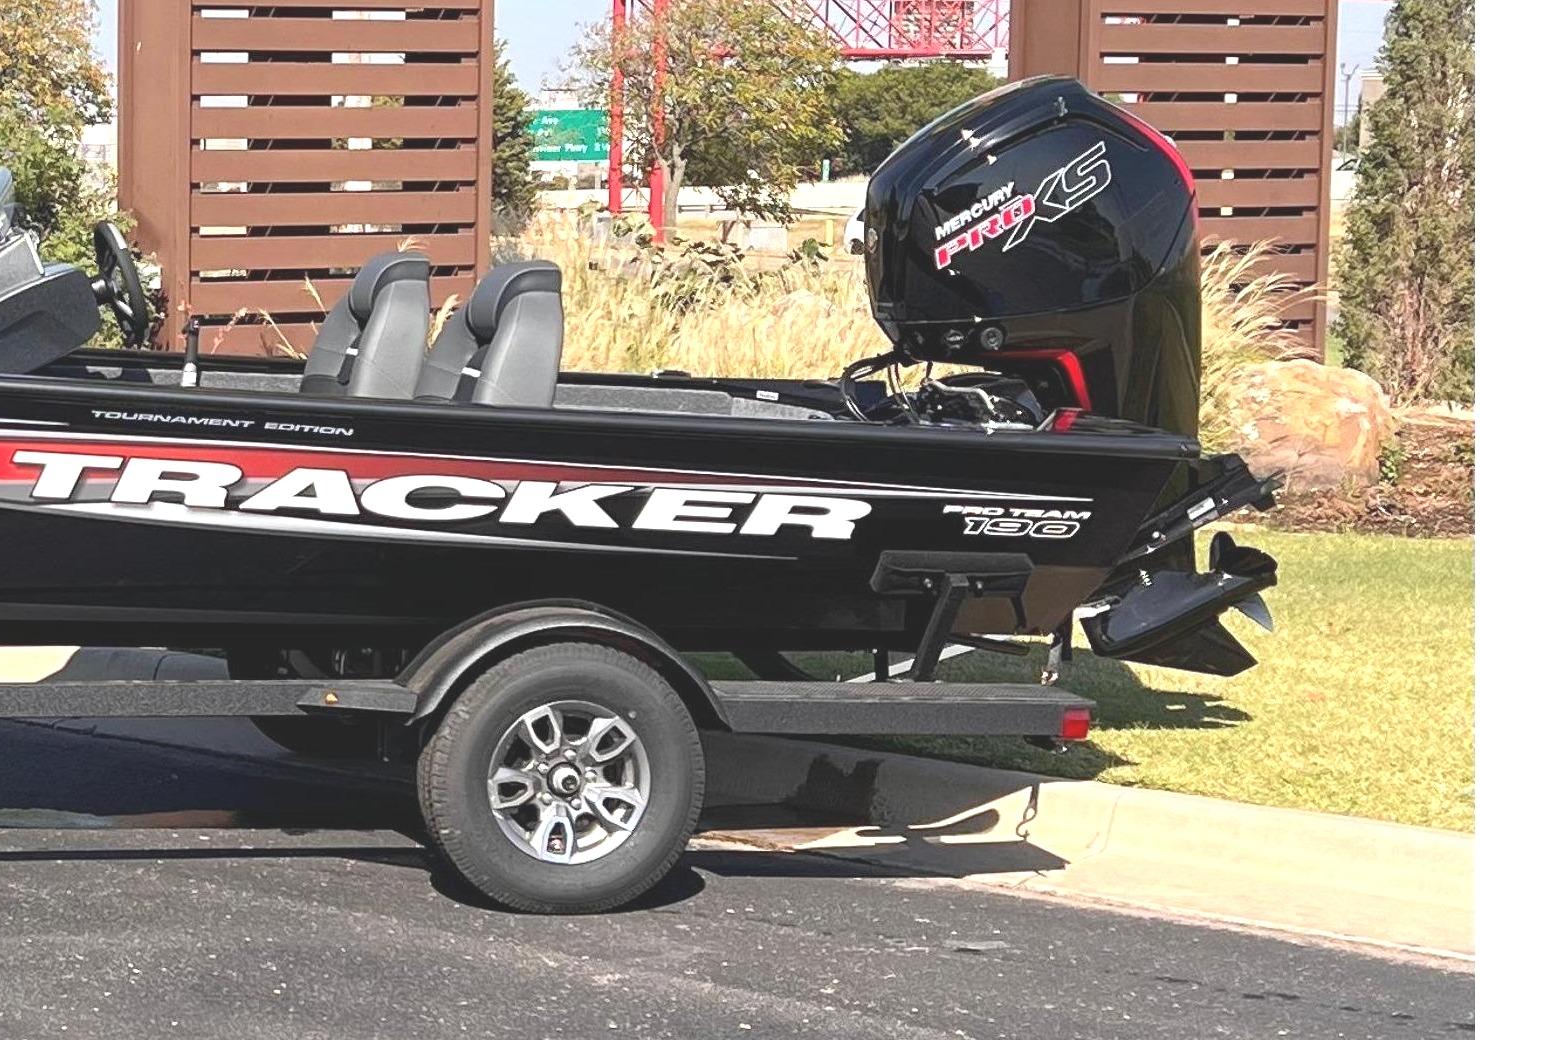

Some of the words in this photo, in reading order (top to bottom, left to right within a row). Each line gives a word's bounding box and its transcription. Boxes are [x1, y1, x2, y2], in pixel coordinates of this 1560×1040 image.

[934, 193, 1036, 270] PRO
[1001, 140, 1112, 253] XS
[934, 181, 1015, 240] MERCURY
[91, 409, 255, 428] TOURNAMENT
[264, 422, 355, 437] EDITION
[12, 450, 872, 540] TRACKER
[942, 504, 1006, 516] PRO
[1009, 507, 1093, 520] TEAM
[963, 516, 1081, 538] 190
